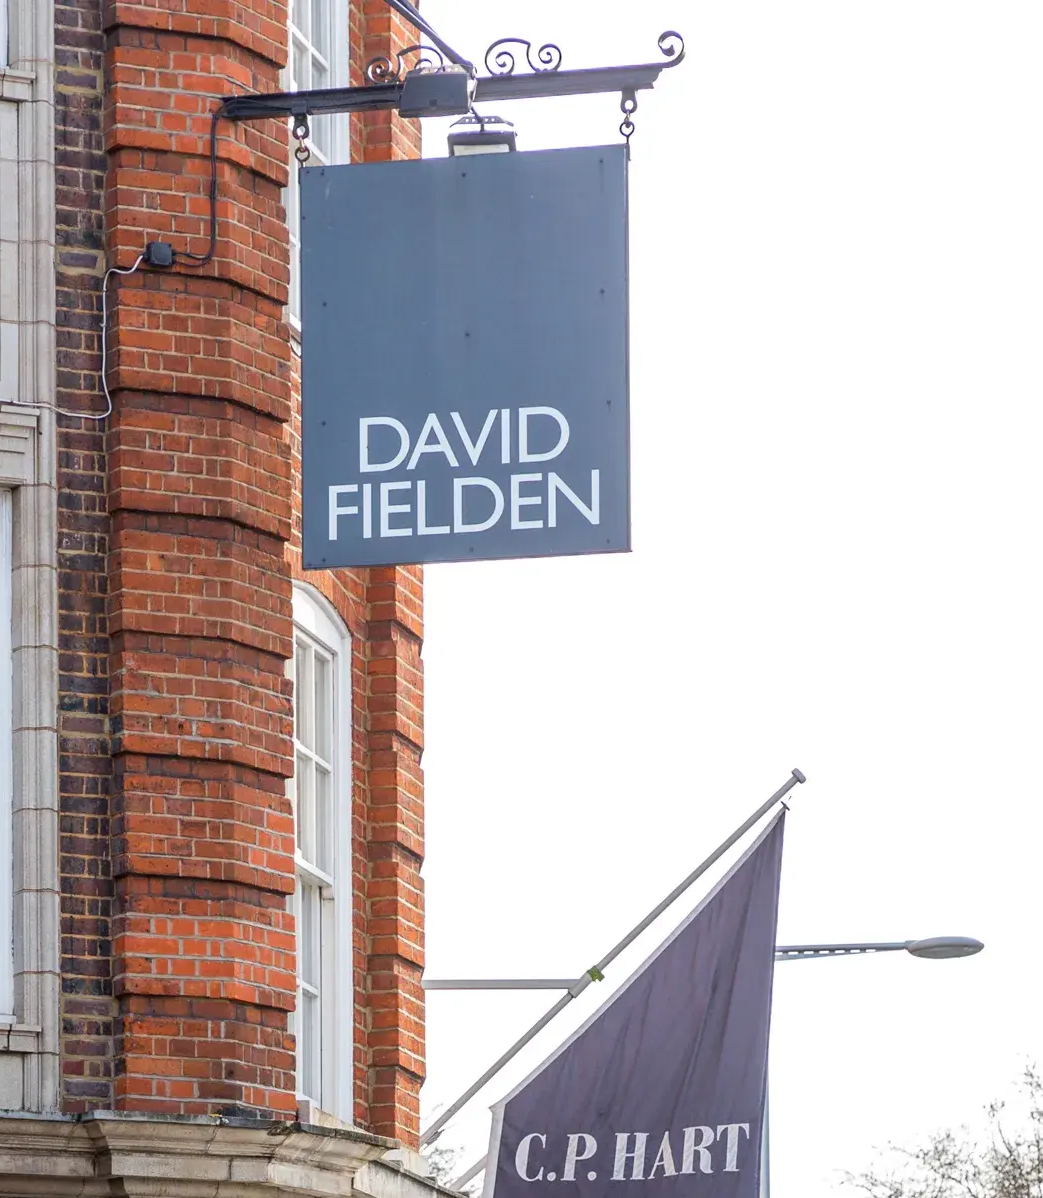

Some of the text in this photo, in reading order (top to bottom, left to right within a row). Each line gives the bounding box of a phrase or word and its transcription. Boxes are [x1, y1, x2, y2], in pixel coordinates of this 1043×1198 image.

[359, 406, 570, 473] DAVID
[328, 469, 600, 540] FIELDEN
[515, 1123, 750, 1181] C.P. HART
